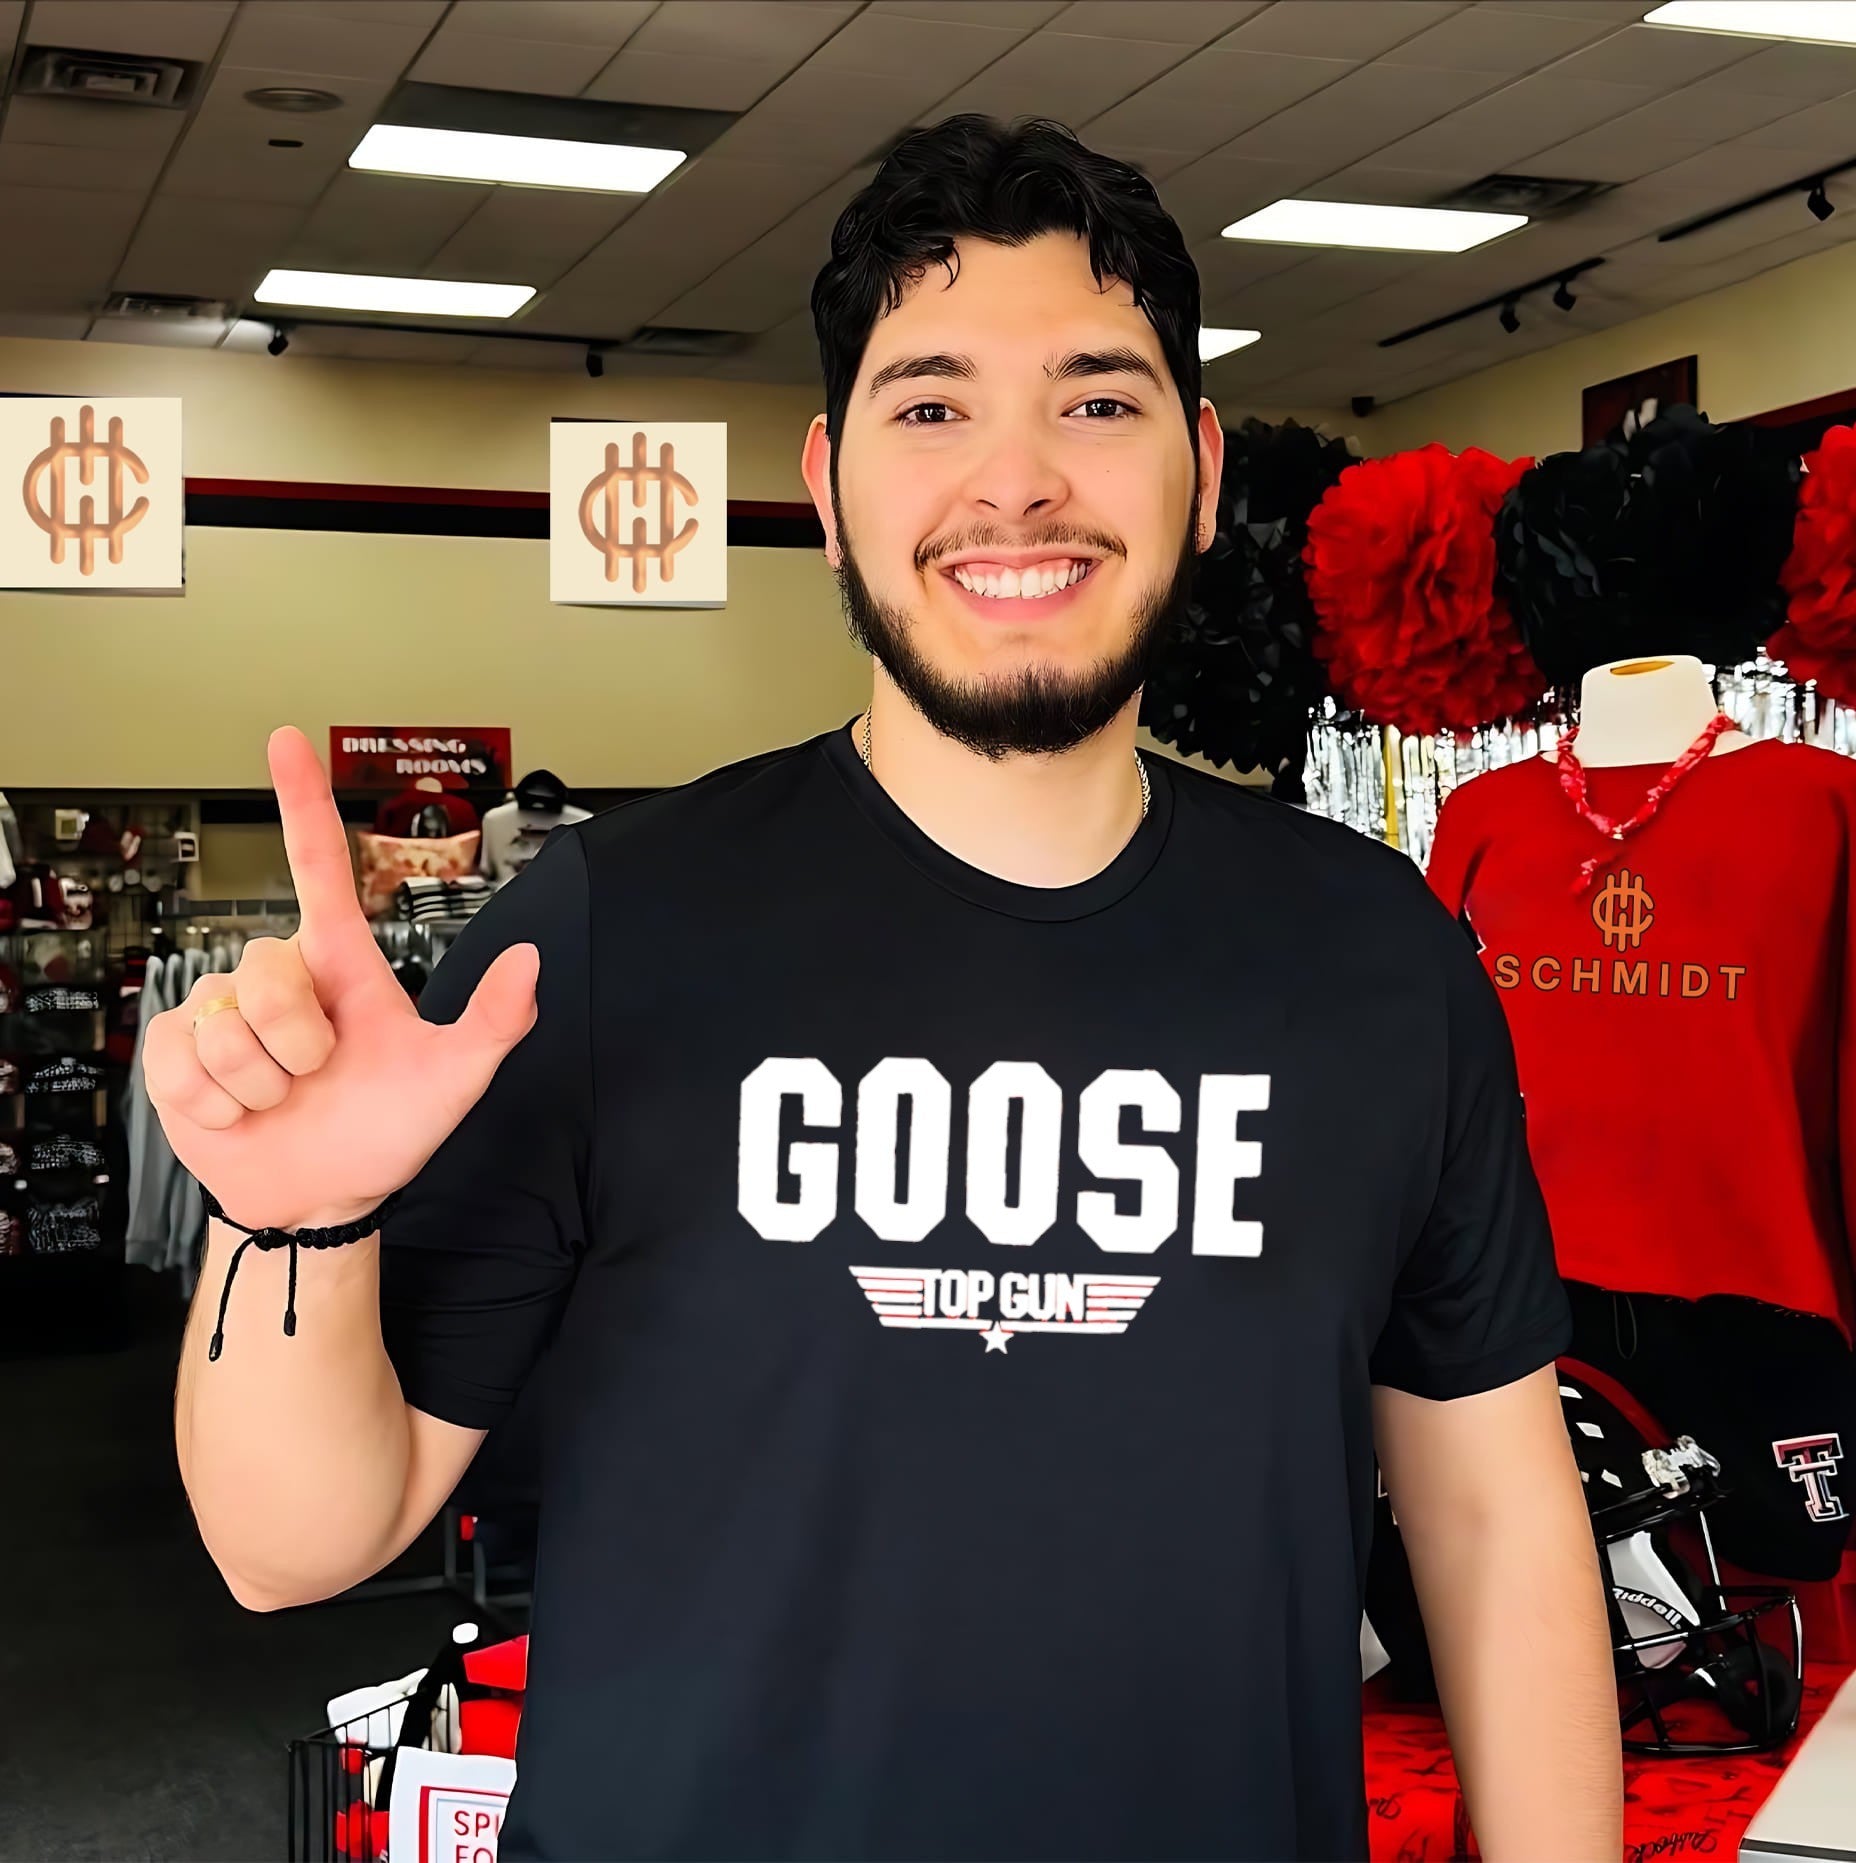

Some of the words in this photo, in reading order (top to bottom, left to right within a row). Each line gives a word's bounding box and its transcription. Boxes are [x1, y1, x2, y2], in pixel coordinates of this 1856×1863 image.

[341, 737, 467, 753] DRESSING
[396, 758, 487, 775] ROOMS
[1494, 953, 1746, 1001] SCHMIDT
[737, 1056, 1271, 1258] GOOSE
[922, 1268, 996, 1319] TOP
[999, 1271, 1086, 1323] GUN
